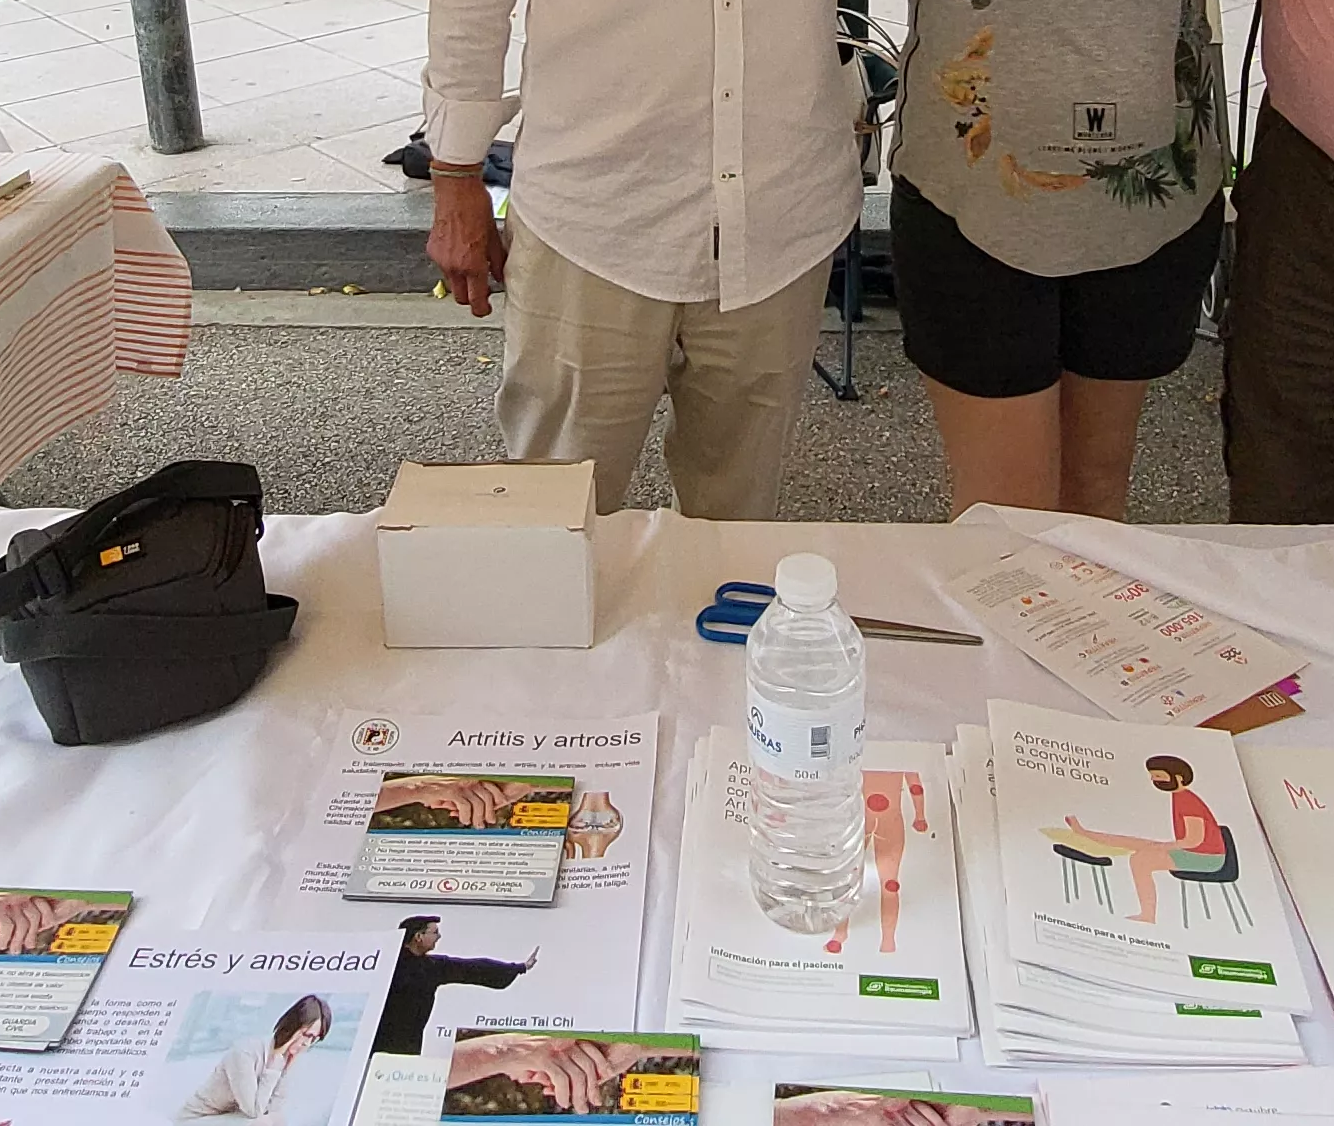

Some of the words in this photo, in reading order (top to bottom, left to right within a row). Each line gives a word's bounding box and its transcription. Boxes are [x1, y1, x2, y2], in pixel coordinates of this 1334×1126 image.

[1086, 107, 1105, 132] W
[1114, 584, 1149, 603] 30%
[1219, 646, 1242, 662] 325
[448, 730, 525, 747] Artritis
[531, 734, 548, 751] y
[553, 729, 643, 748] artrosis
[1013, 731, 1115, 761] Aprendiendo
[1015, 745, 1025, 754] a
[1029, 747, 1091, 769] convivir
[1016, 758, 1047, 773] con
[1051, 763, 1065, 777] la
[1069, 768, 1109, 786] Gota
[1283, 779, 1326, 811] Mi
[409, 880, 433, 890] 091
[461, 881, 487, 891] 062
[1093, 927, 1116, 940] para
[1117, 934, 1127, 942] el
[1129, 937, 1171, 950] paciente
[129, 947, 218, 970] Estrés
[223, 953, 244, 974] y
[249, 949, 381, 972] ansiedad
[710, 946, 767, 967] Información
[768, 960, 790, 968] para
[791, 960, 801, 968] el
[803, 961, 844, 971] paciente
[105, 999, 132, 1008] forma
[136, 1000, 162, 1008] como
[167, 999, 178, 1008] el
[112, 1009, 161, 1018] responden
[476, 1014, 528, 1028] Practica
[531, 1015, 549, 1027] Tai
[552, 1015, 574, 1028] Chi
[86, 1027, 117, 1037] trabajo
[137, 1028, 149, 1036] en
[153, 1028, 163, 1037] la
[435, 1026, 452, 1038] Tu
[85, 1037, 133, 1047] importante
[149, 1038, 159, 1047] la
[39, 1066, 80, 1075] nuestra
[85, 1067, 115, 1076] salud
[119, 1069, 127, 1078] y
[132, 1069, 144, 1077] es
[34, 1077, 69, 1087] prestar
[73, 1077, 114, 1087] atención
[130, 1080, 140, 1088] la
[10, 1087, 28, 1096] que
[52, 1088, 109, 1098] enfrentamos
